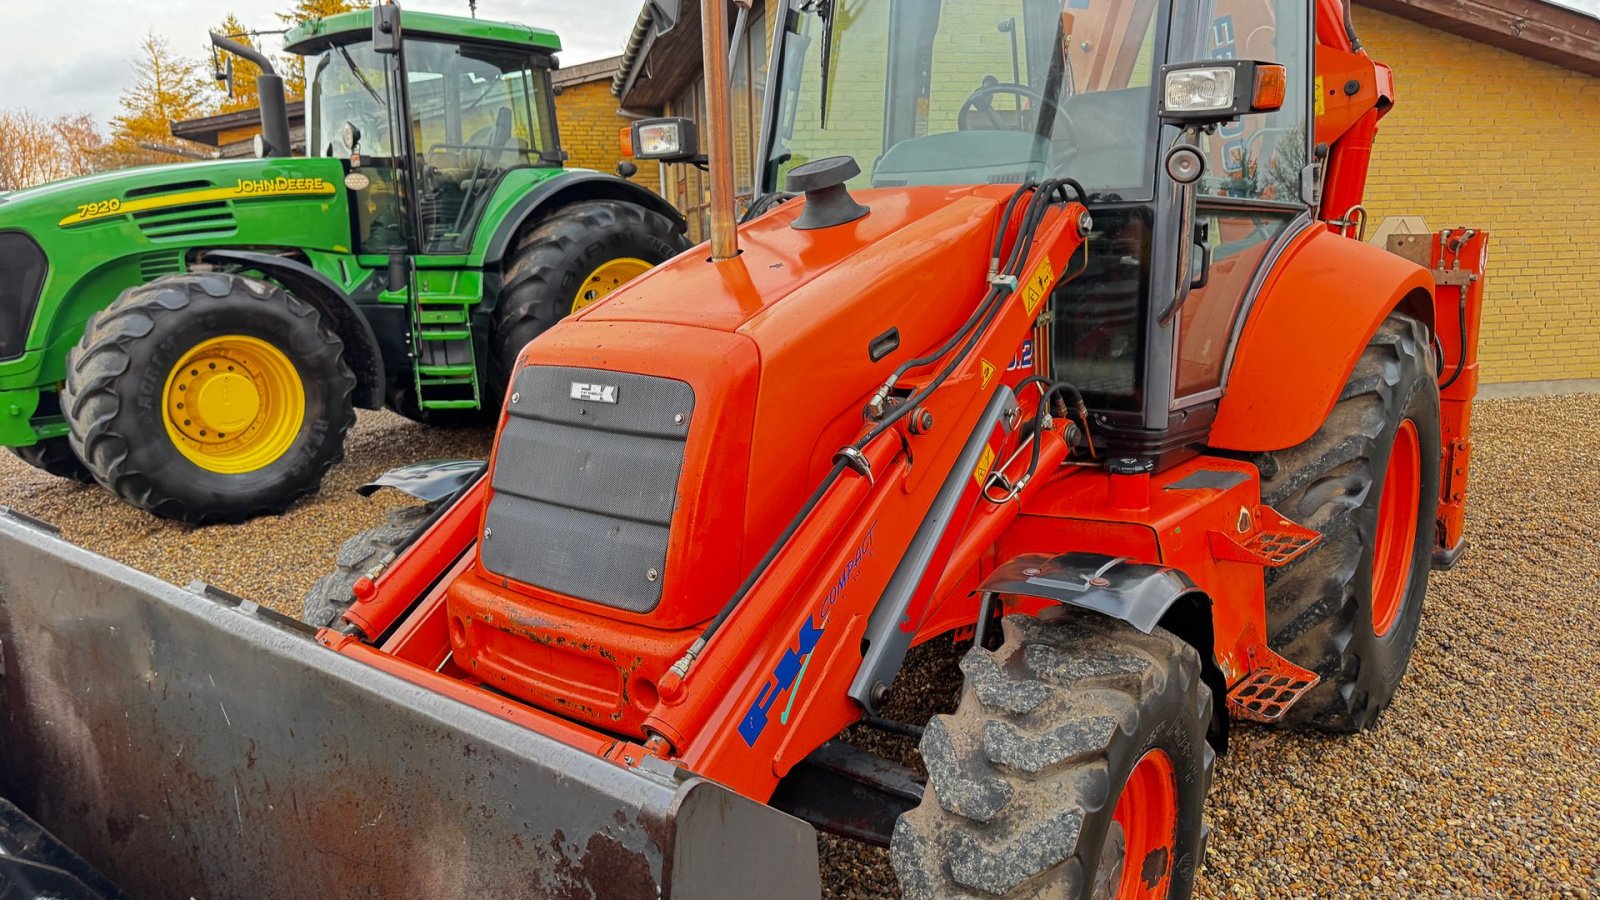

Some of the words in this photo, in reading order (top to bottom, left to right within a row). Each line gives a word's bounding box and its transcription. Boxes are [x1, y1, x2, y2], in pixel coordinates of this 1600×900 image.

[233, 178, 275, 193] JOHN
[274, 176, 324, 190] DEERE
[77, 198, 121, 218] 7920
[819, 519, 879, 620] COMPACT
